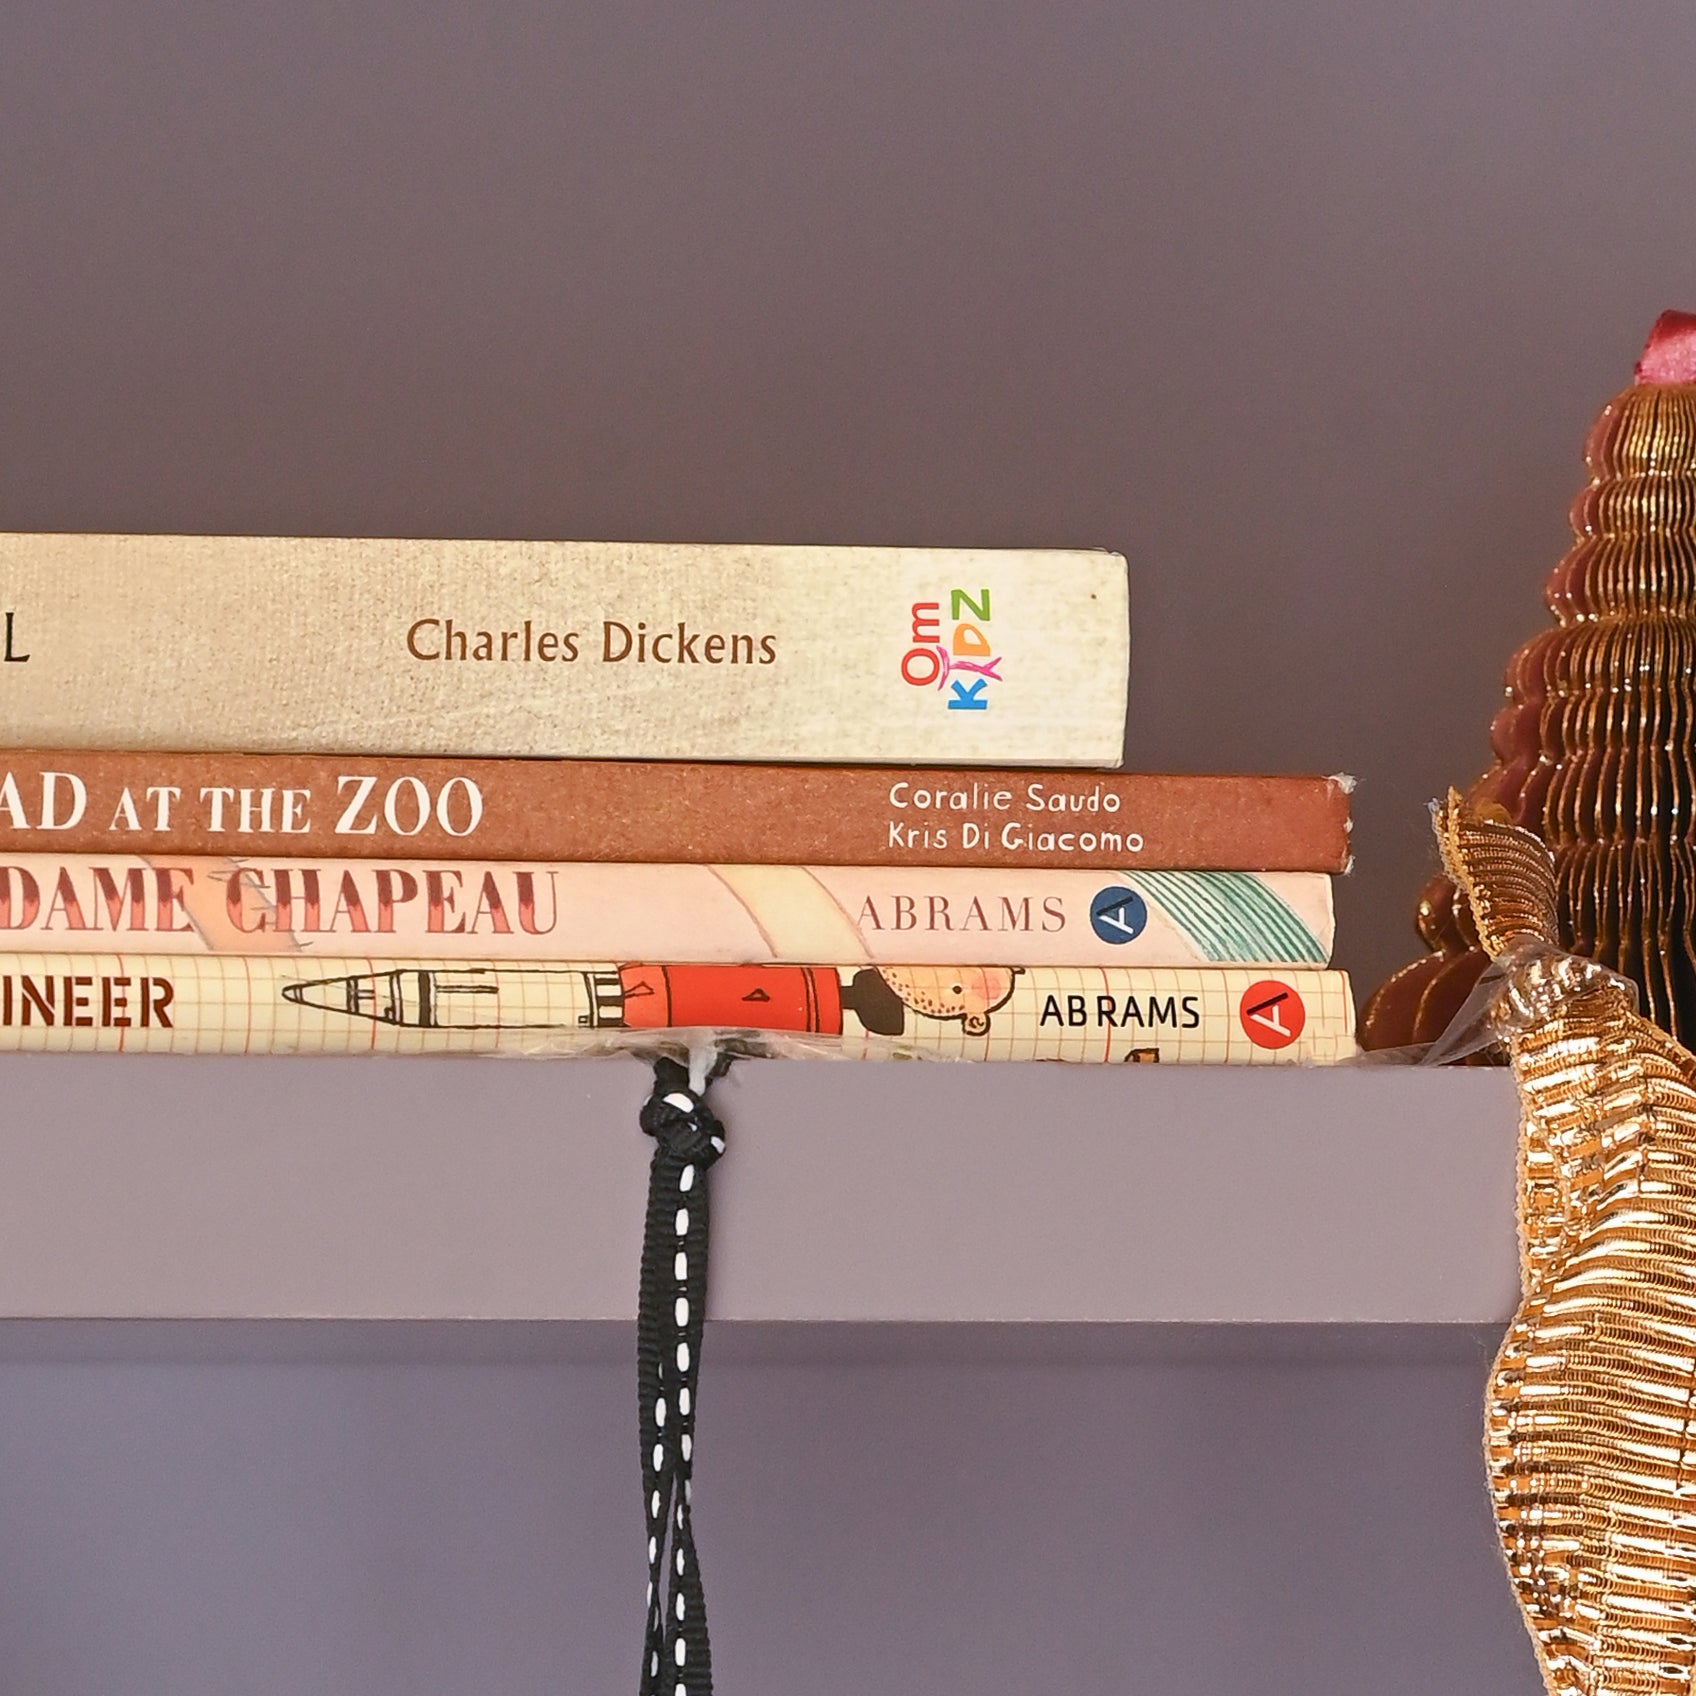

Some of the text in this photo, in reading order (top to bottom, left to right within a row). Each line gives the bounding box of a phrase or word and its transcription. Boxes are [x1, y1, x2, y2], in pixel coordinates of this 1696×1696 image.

[406, 618, 580, 663] Charles
[601, 620, 777, 665] Dickens
[901, 602, 940, 686] Om
[109, 786, 181, 831] AT
[200, 787, 311, 834] THE
[334, 775, 484, 837] ZOO
[889, 782, 1121, 813] Coralie Saudo
[888, 821, 1144, 852] Kris Di Giacomo
[0, 866, 559, 935] DAME CHAPEAU
[856, 895, 1066, 932] ABRAMS
[2, 975, 175, 1028] INEER
[1040, 994, 1200, 1028] ABRAMS
